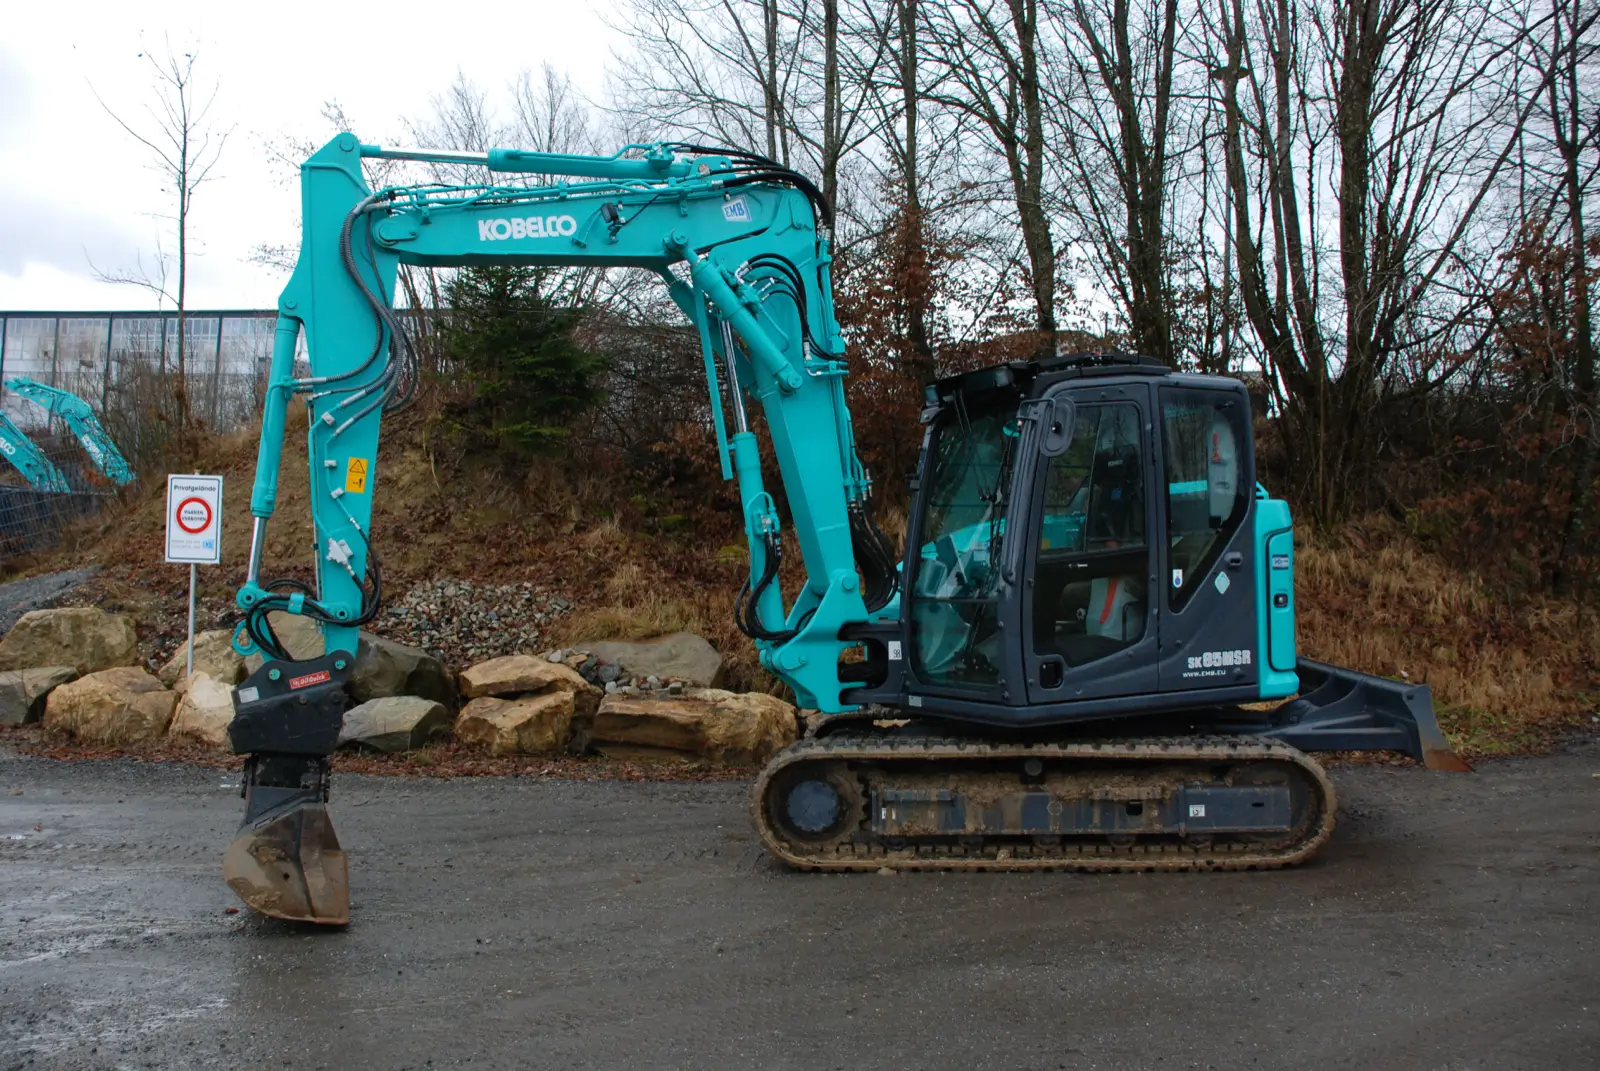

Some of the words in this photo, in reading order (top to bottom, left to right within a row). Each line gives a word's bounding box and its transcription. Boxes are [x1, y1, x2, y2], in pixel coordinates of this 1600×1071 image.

[724, 202, 745, 218] EMB
[478, 215, 577, 241] KOBELCO
[1187, 649, 1252, 669] SK85MSR
